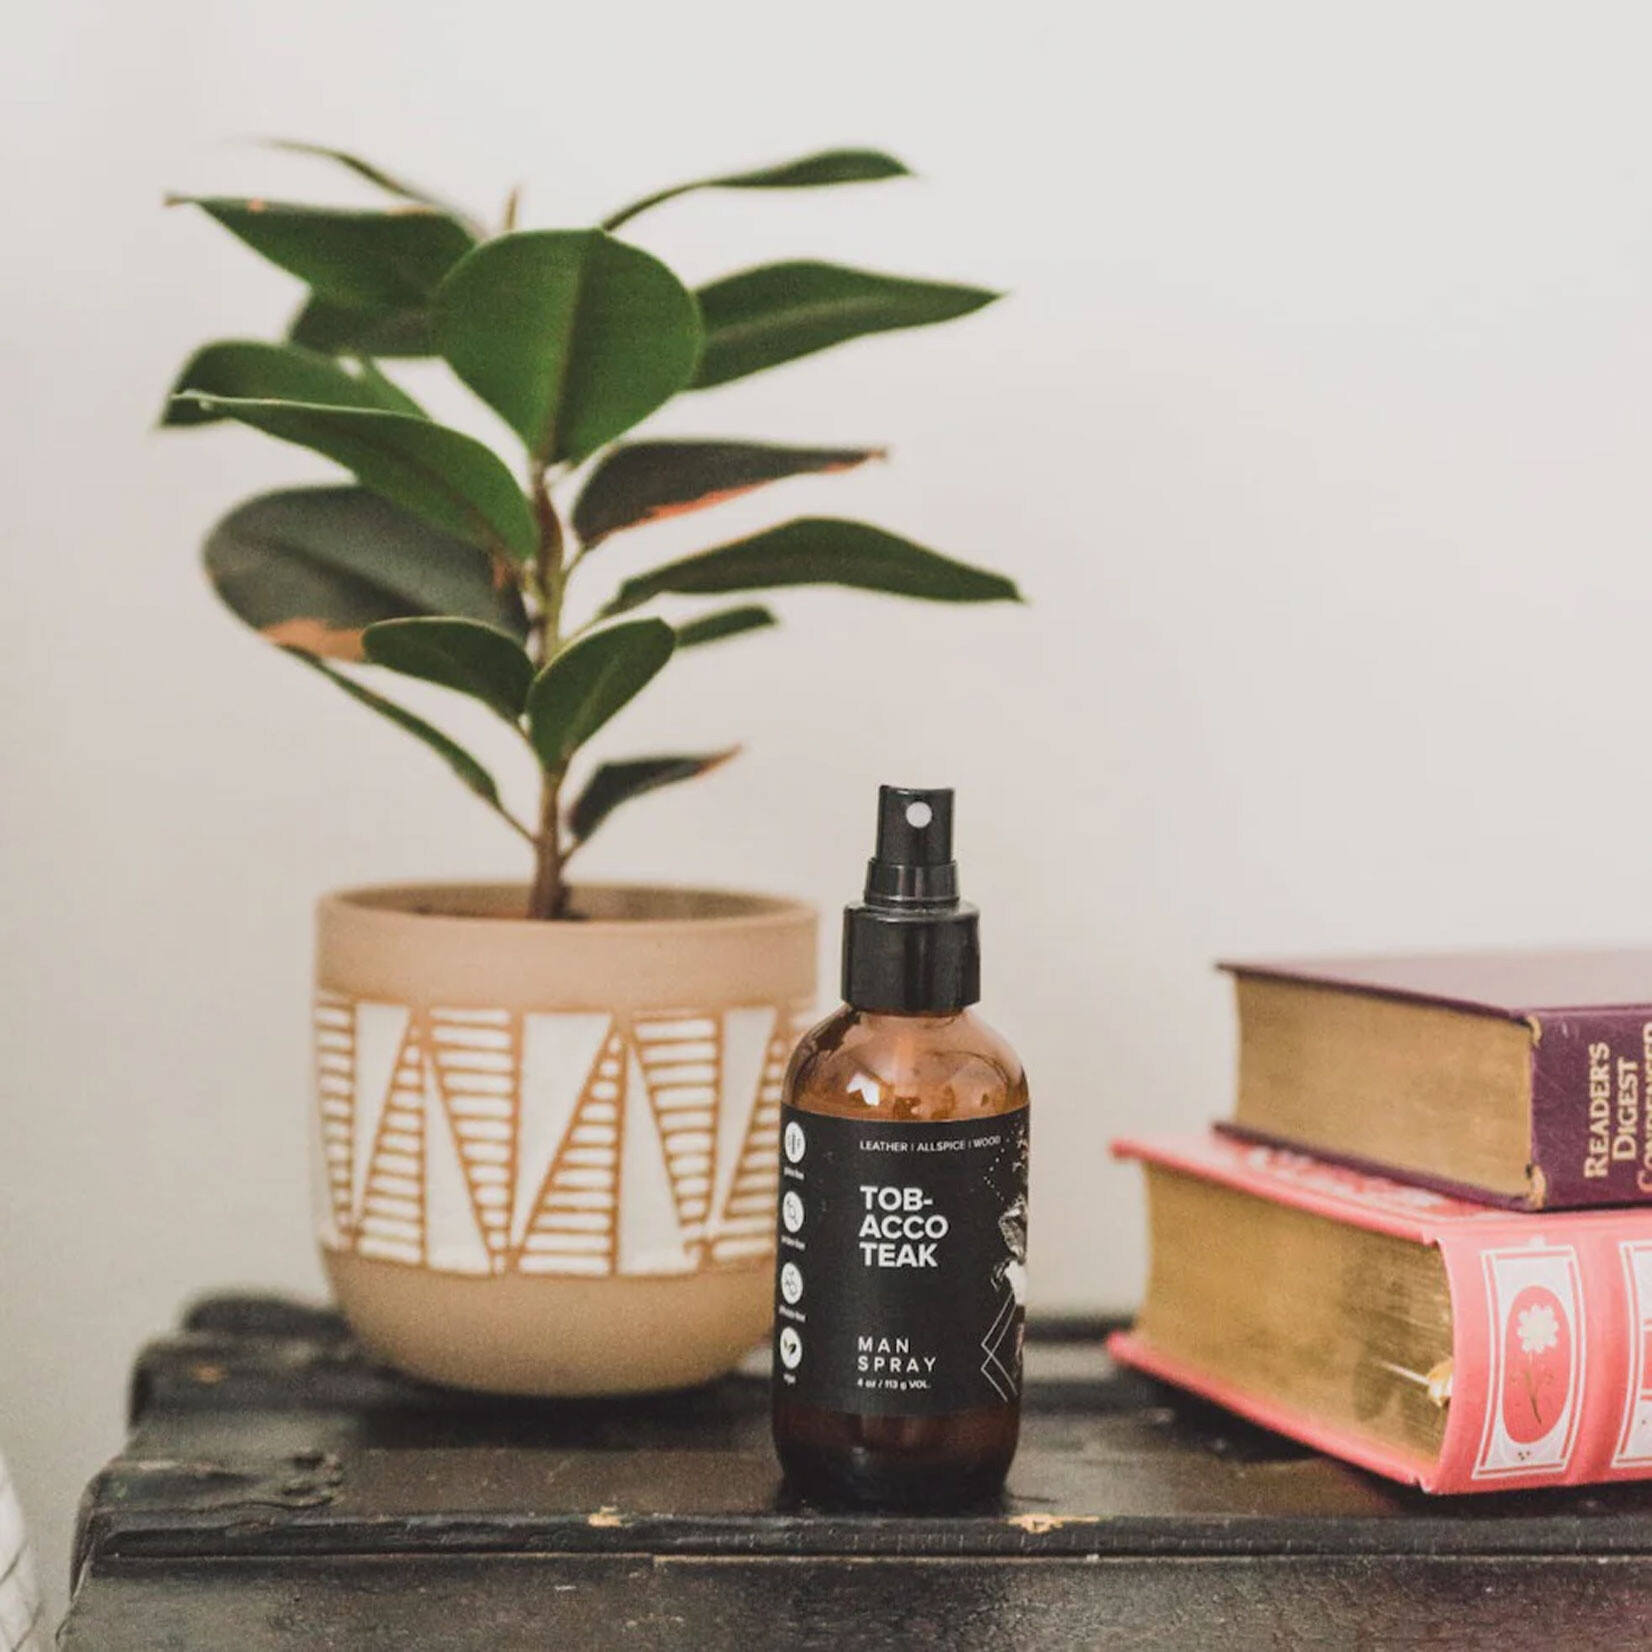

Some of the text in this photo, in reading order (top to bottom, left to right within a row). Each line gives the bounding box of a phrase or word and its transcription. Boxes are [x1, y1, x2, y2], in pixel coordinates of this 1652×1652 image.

[1584, 1041, 1610, 1178] READER'S
[1612, 1057, 1638, 1160] DIGEST
[860, 1140, 908, 1152] LEATHER
[917, 1140, 965, 1151] ALLSPICE
[973, 1135, 1001, 1148] WOOD
[859, 1185, 933, 1211] TOB-
[859, 1214, 949, 1240] ACCO
[859, 1241, 938, 1268] TEAK
[858, 1336, 910, 1353] MAN
[857, 1356, 937, 1373] SPRAY
